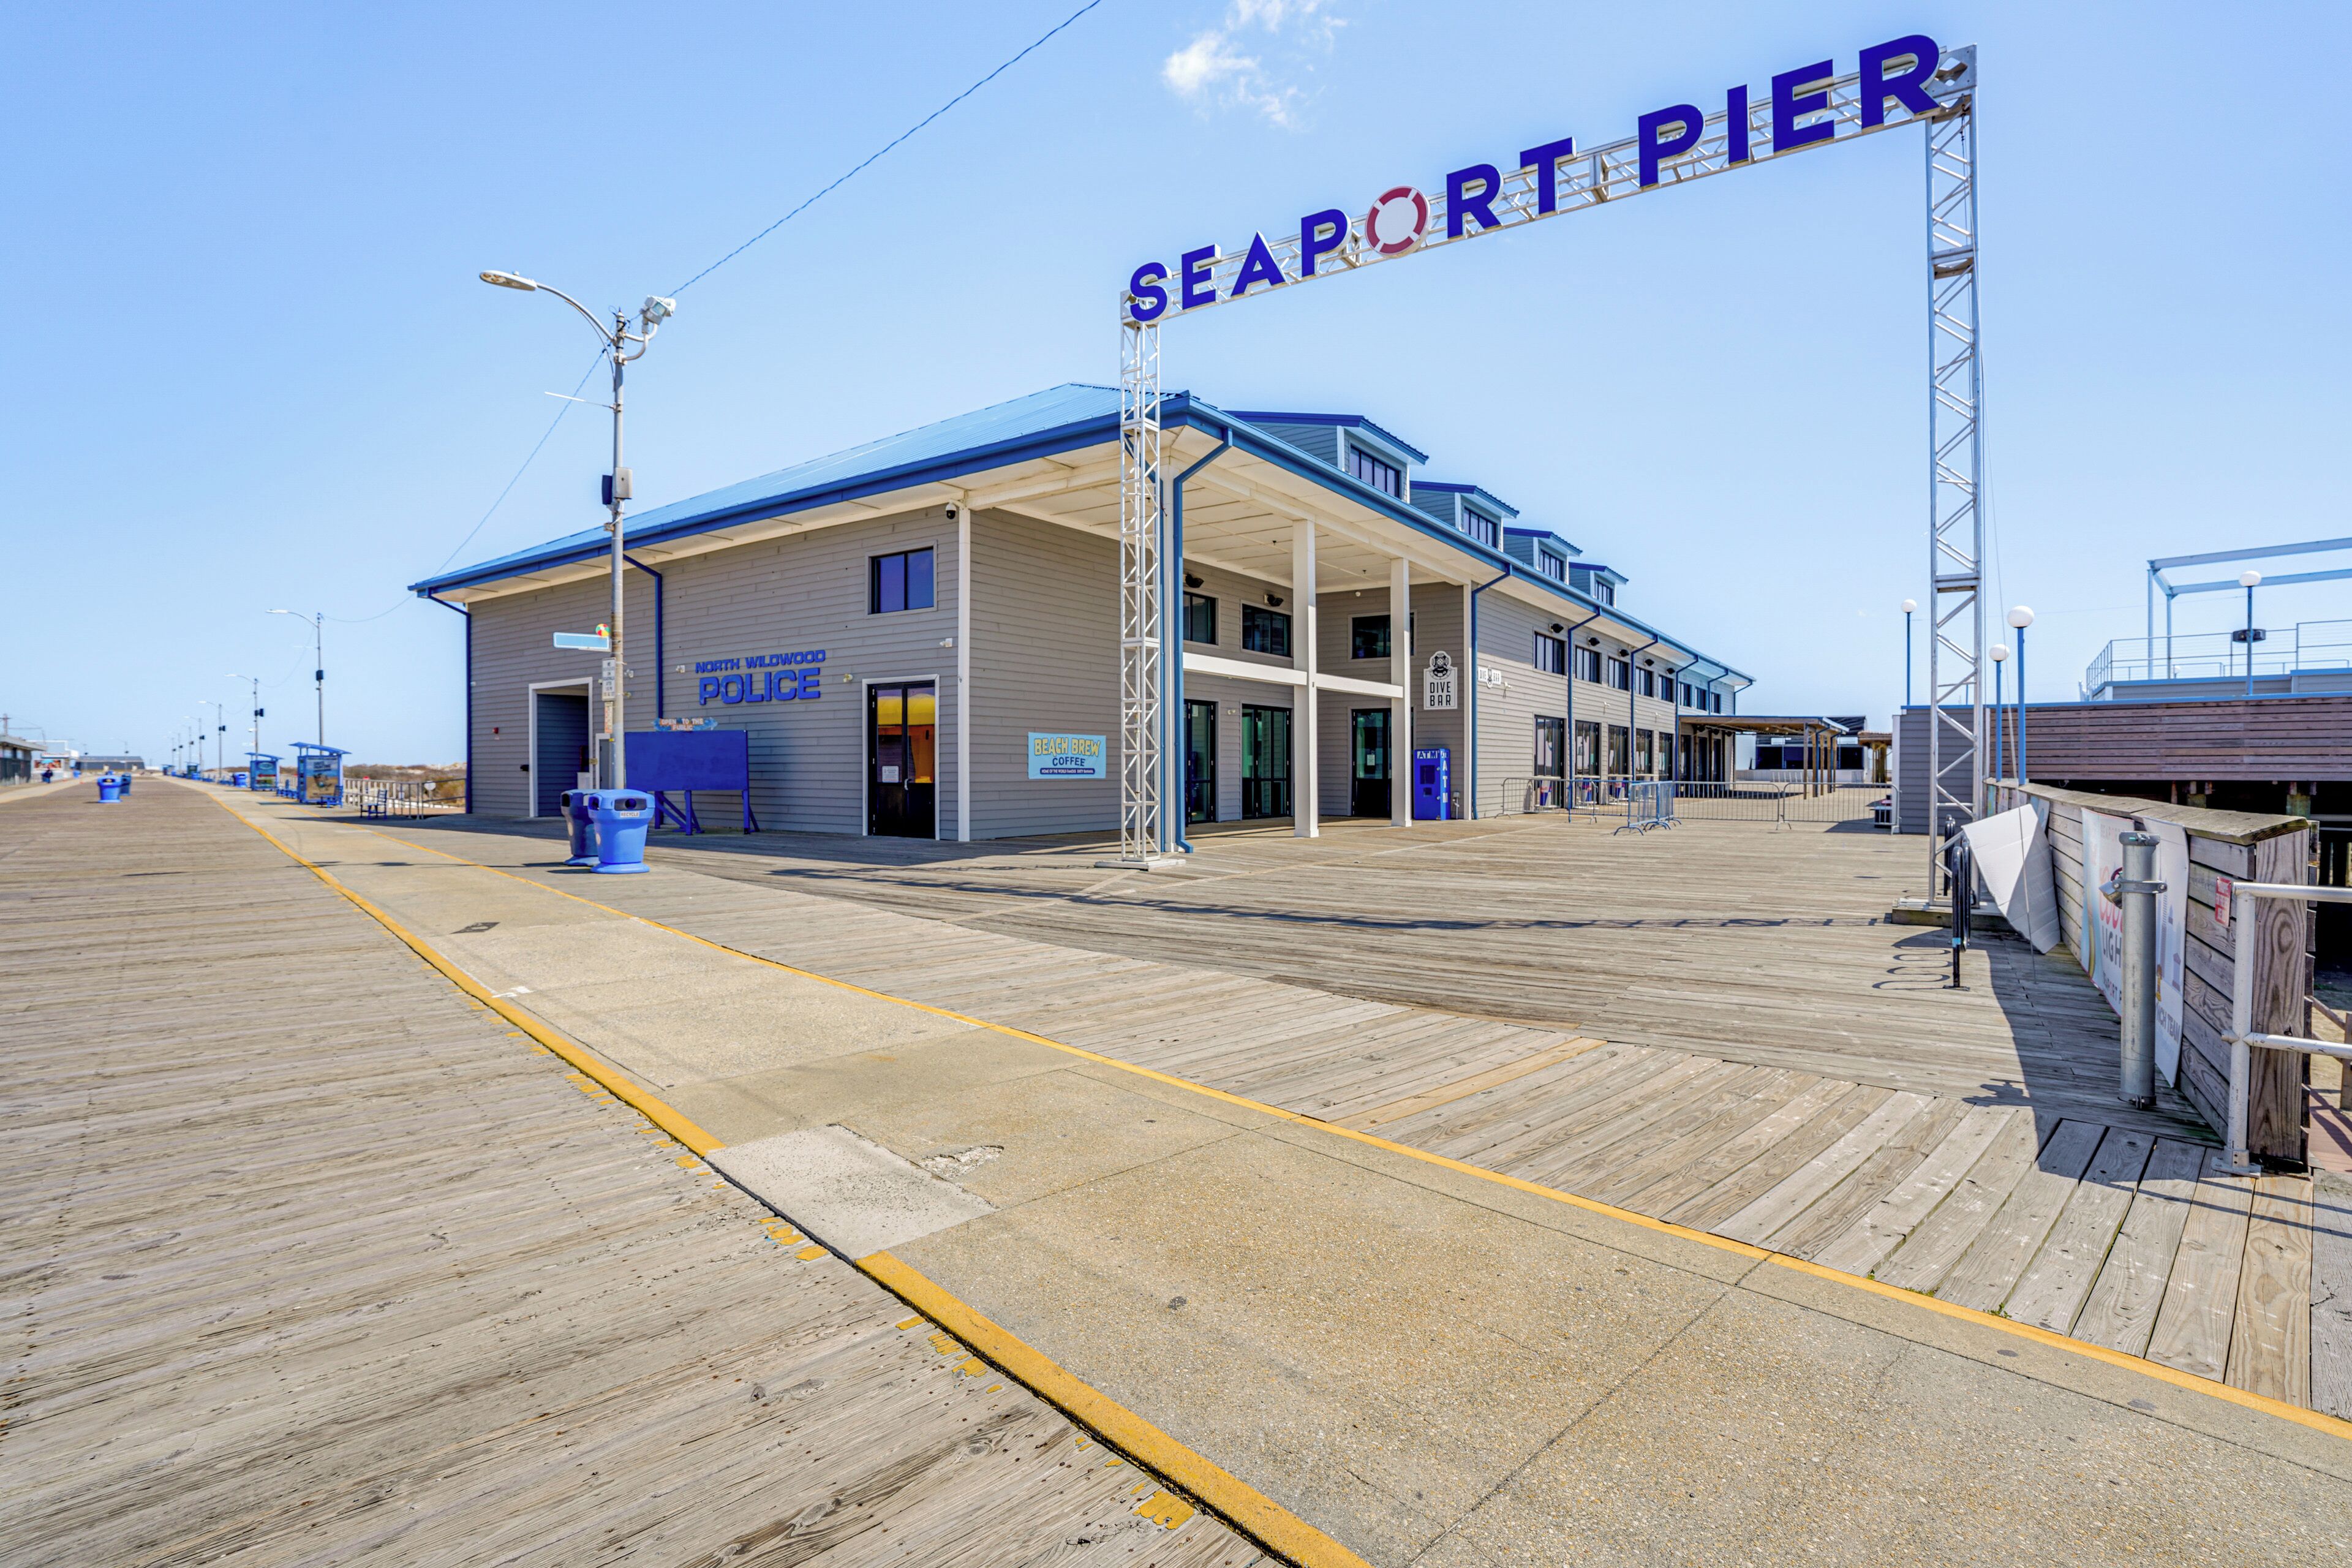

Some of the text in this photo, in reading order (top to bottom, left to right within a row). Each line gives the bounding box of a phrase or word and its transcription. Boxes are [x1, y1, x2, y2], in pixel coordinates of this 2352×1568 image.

[1129, 35, 1940, 323] SEAPORT PIER
[695, 649, 826, 673] NORTH WILDWOOD
[699, 668, 820, 705] POLICE
[1430, 682, 1451, 693] DIVE
[1430, 695, 1451, 706] BAR
[1034, 737, 1101, 757] BEACH BREW
[1052, 756, 1085, 766] COFFEE
[2102, 925, 2122, 968] LIGH
[2167, 1014, 2180, 1044] TEAM
